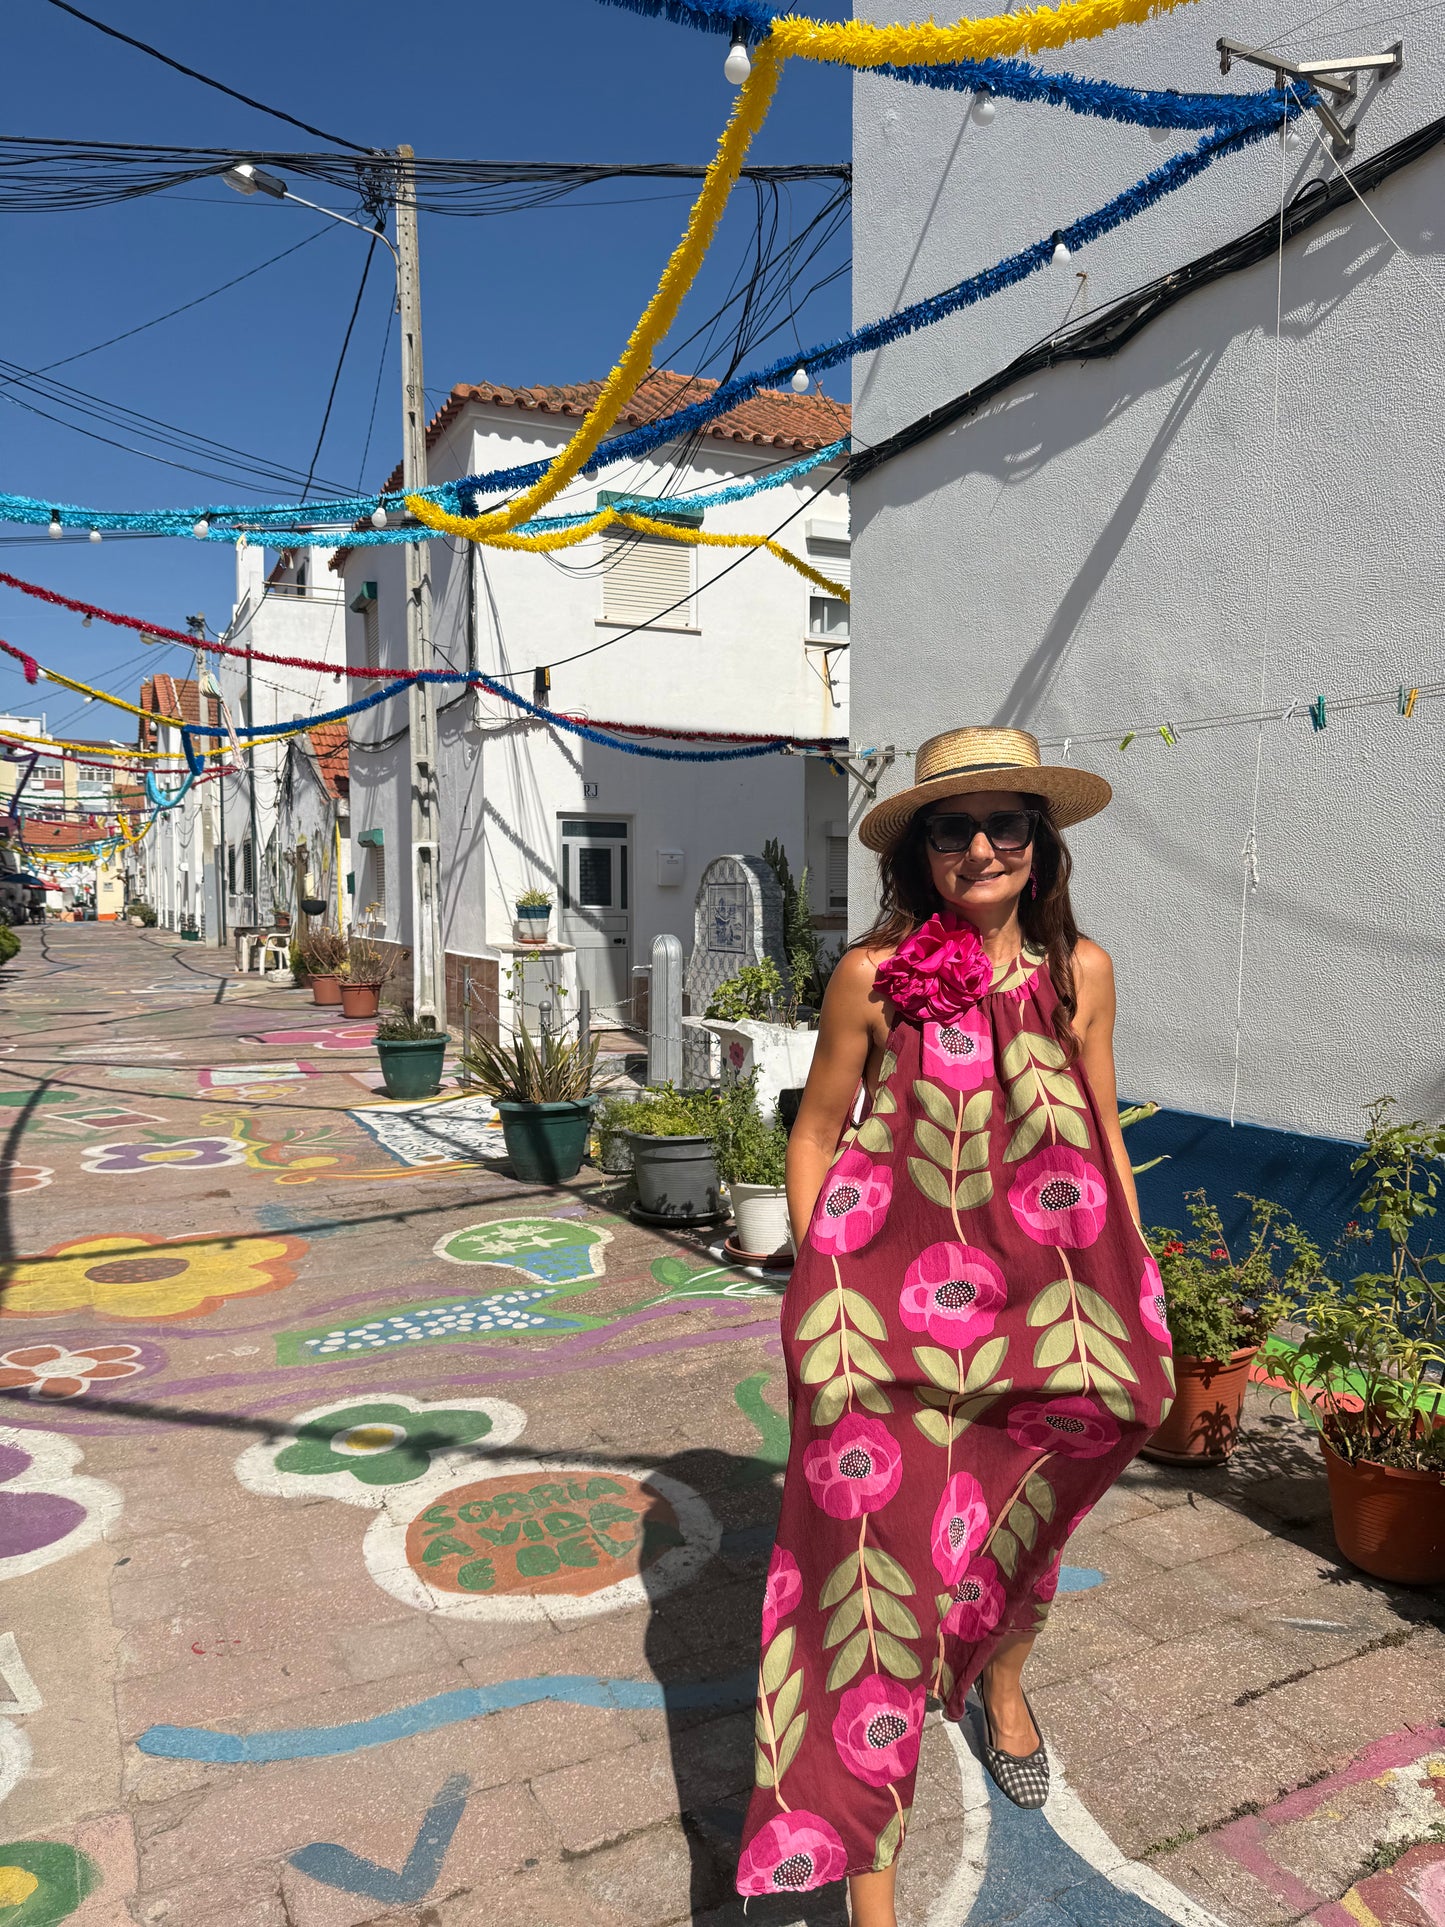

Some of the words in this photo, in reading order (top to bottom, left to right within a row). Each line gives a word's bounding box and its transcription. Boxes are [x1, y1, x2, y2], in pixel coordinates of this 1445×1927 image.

[421, 1476, 627, 1536] SORRIA
[422, 1534, 475, 1567] A
[475, 1502, 641, 1547] VIDA
